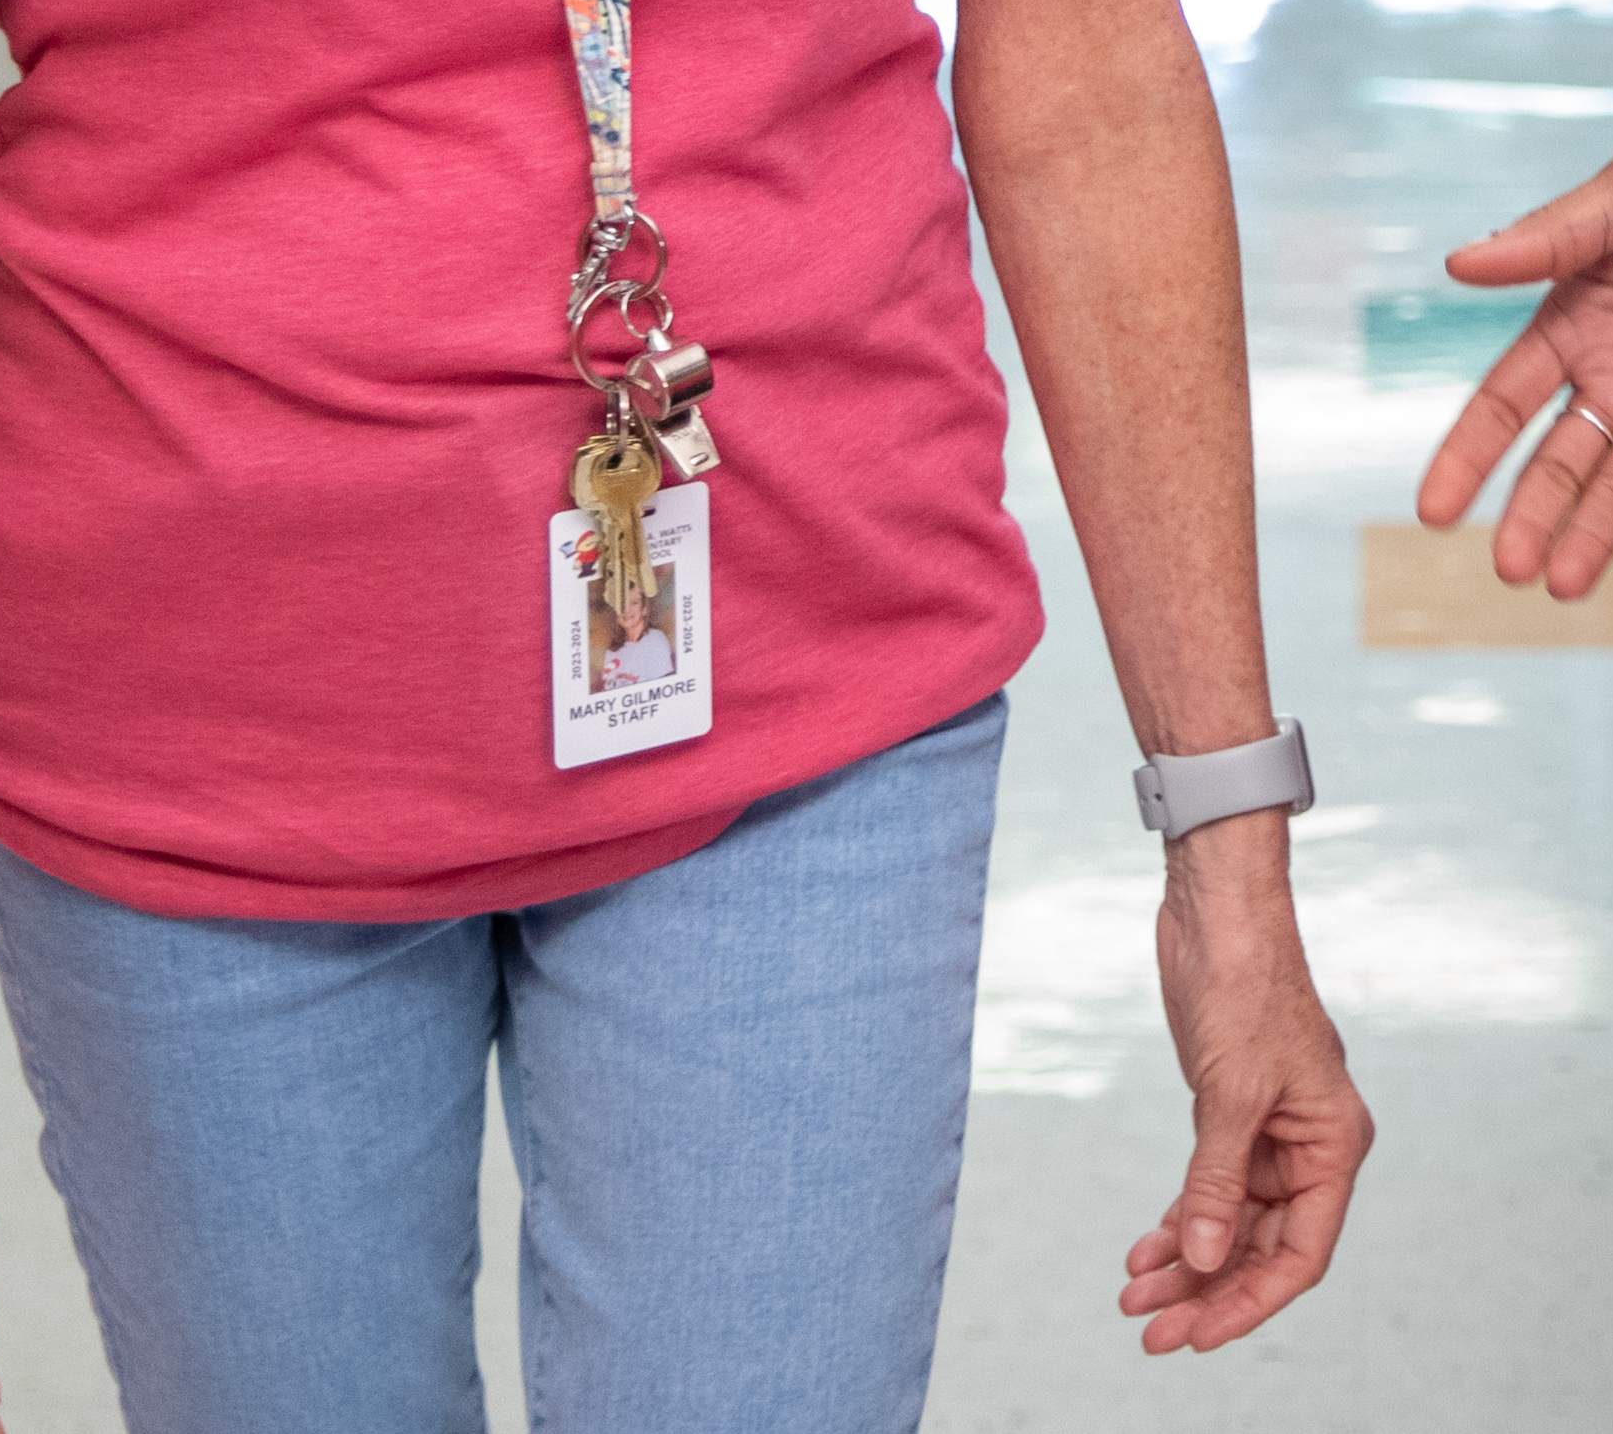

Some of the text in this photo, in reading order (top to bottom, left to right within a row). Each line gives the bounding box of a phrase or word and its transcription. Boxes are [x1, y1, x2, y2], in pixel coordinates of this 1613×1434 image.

[659, 523, 692, 537] WATTS
[646, 536, 682, 549] NTARY
[650, 549, 672, 560] OOL
[682, 594, 693, 654] 2023-2024
[571, 620, 582, 680] 2023-2024
[570, 697, 617, 720] MARY
[621, 678, 697, 707] GILMORE
[608, 704, 659, 728] STAFF
